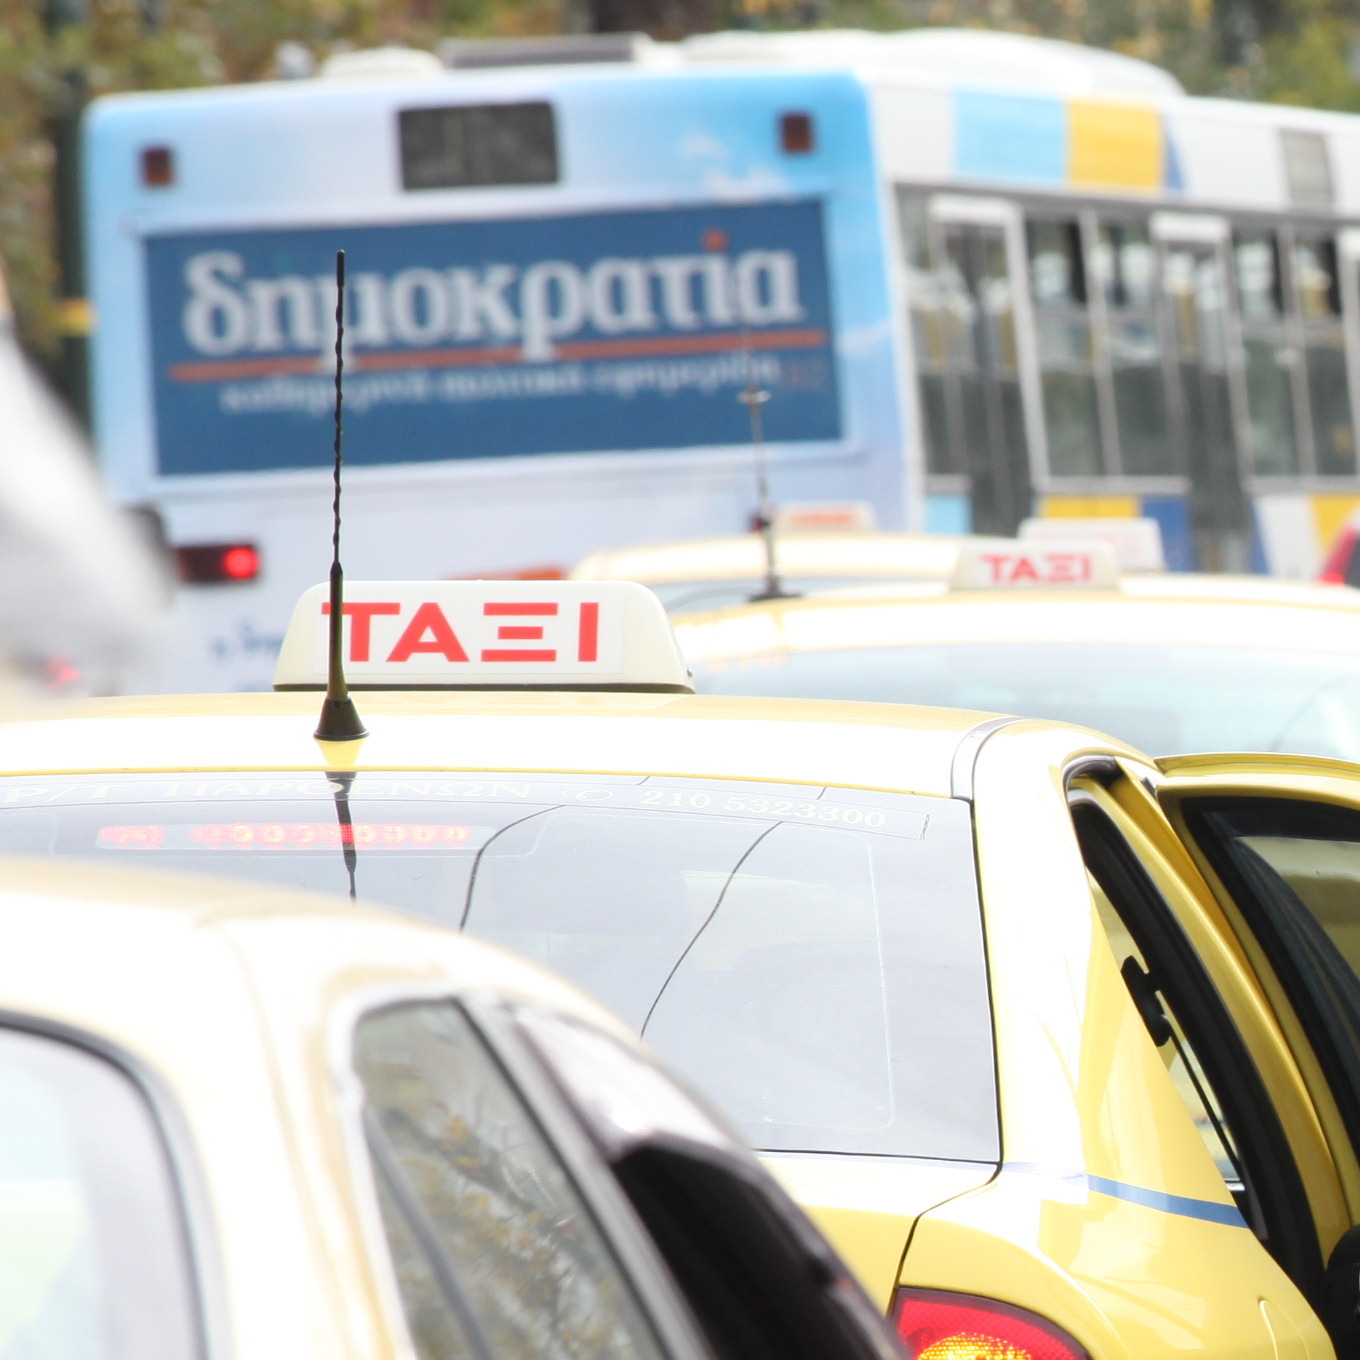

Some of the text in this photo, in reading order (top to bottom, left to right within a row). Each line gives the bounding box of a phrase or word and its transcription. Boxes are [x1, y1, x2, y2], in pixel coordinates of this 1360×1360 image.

[980, 553, 1092, 584] ΤΑΞΙ
[322, 602, 599, 663] ΤΑΞΙ
[641, 789, 712, 809] 210
[724, 795, 886, 828] 5323300
